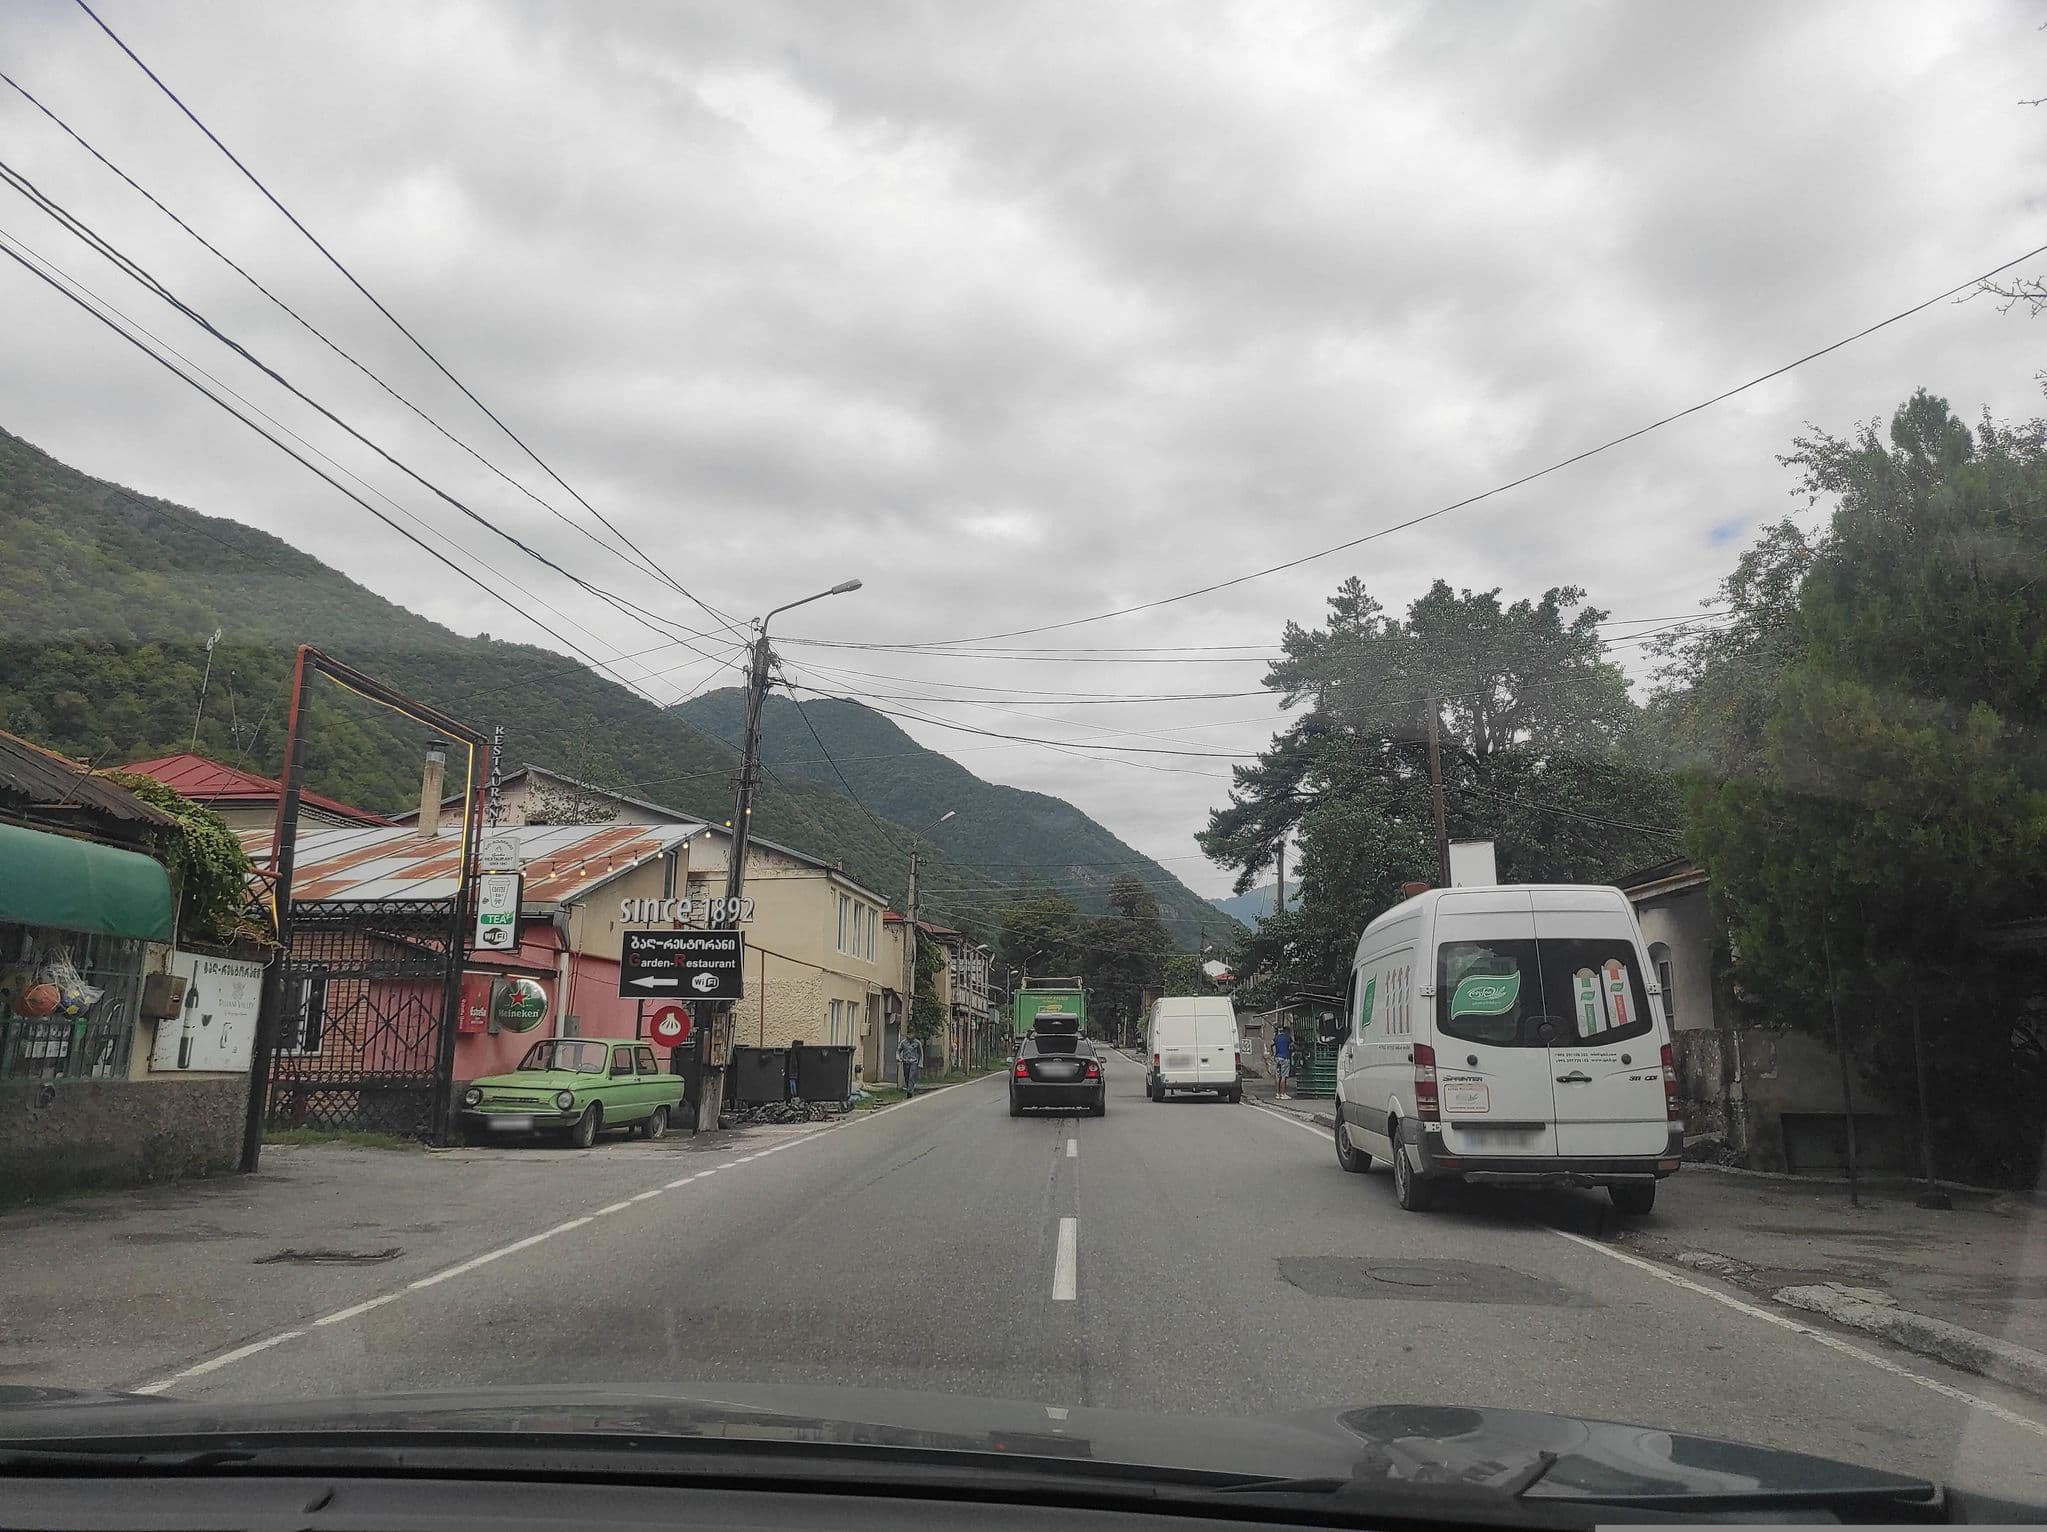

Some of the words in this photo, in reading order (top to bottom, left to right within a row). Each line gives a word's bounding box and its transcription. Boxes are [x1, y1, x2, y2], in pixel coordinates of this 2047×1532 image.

[489, 725, 504, 828] RESTAURANT
[702, 896, 755, 924] 1892
[487, 914, 507, 924] TEA
[630, 935, 736, 951] ბაღ-რესტორანი
[498, 1009, 539, 1018] Heineken
